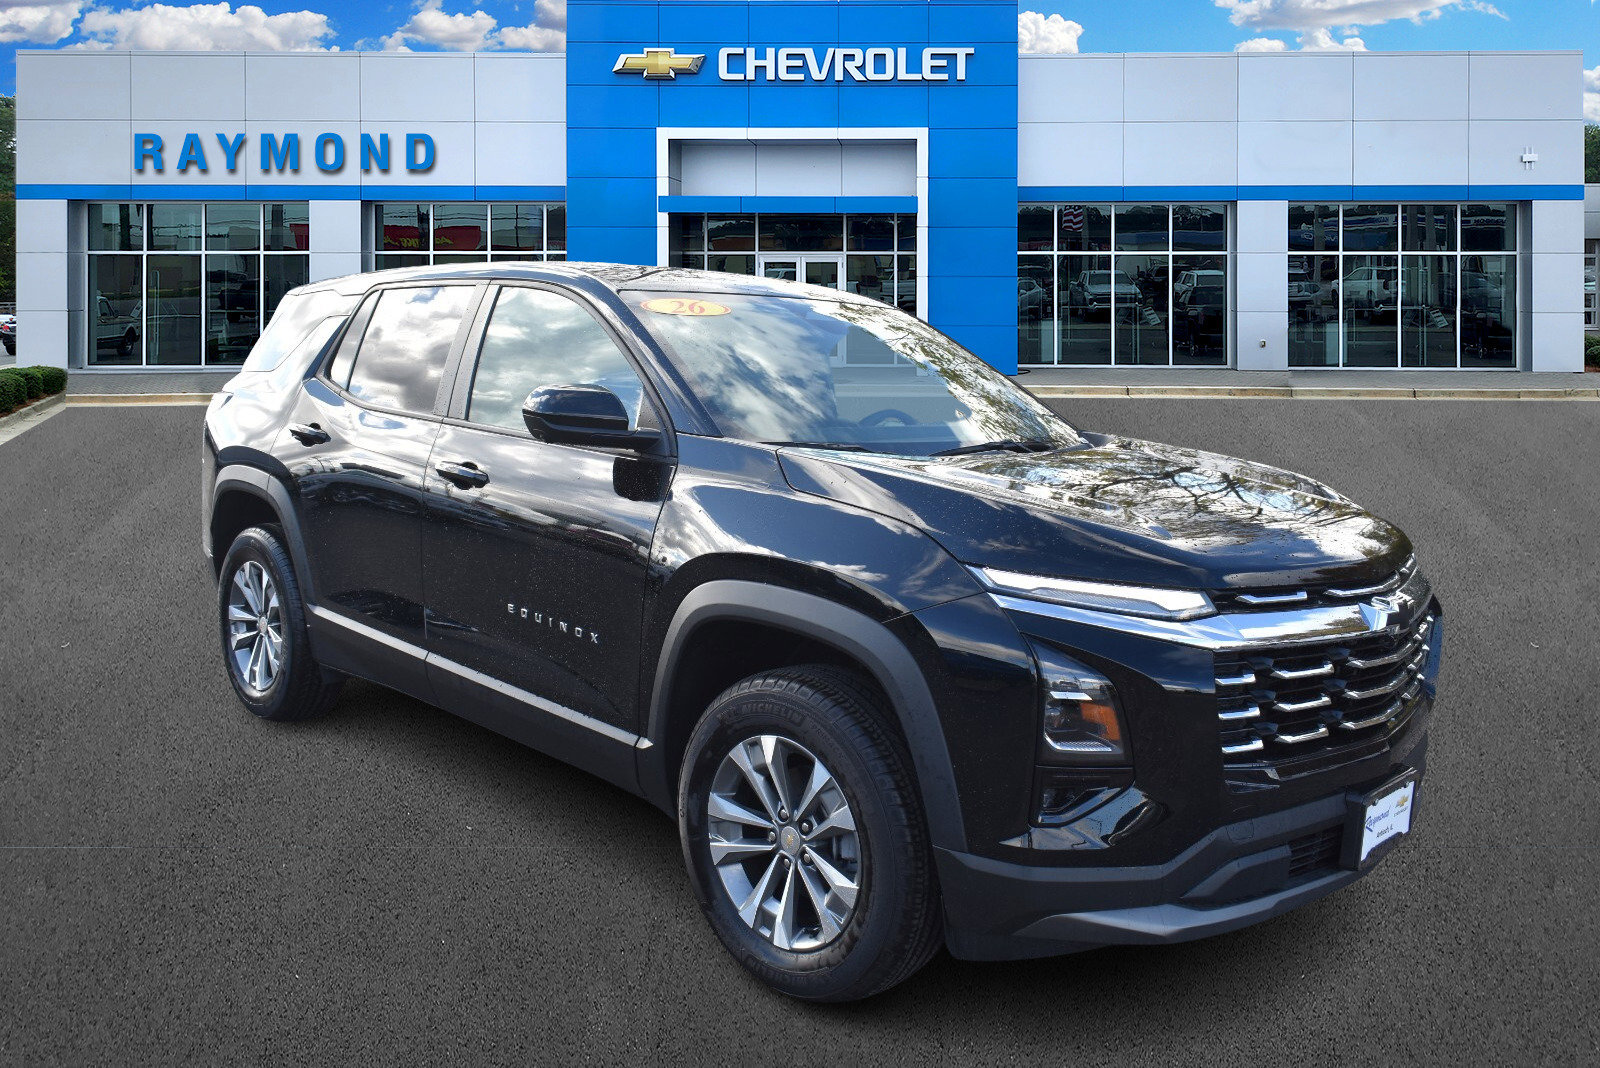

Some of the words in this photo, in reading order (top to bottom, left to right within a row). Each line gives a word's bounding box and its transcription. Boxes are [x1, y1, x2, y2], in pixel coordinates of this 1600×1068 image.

[717, 47, 975, 82] CHEVROLET
[134, 132, 436, 171] RAYMOND
[671, 300, 705, 314] 26
[507, 603, 599, 644] EQUINOX
[741, 703, 802, 723] MICHELIN
